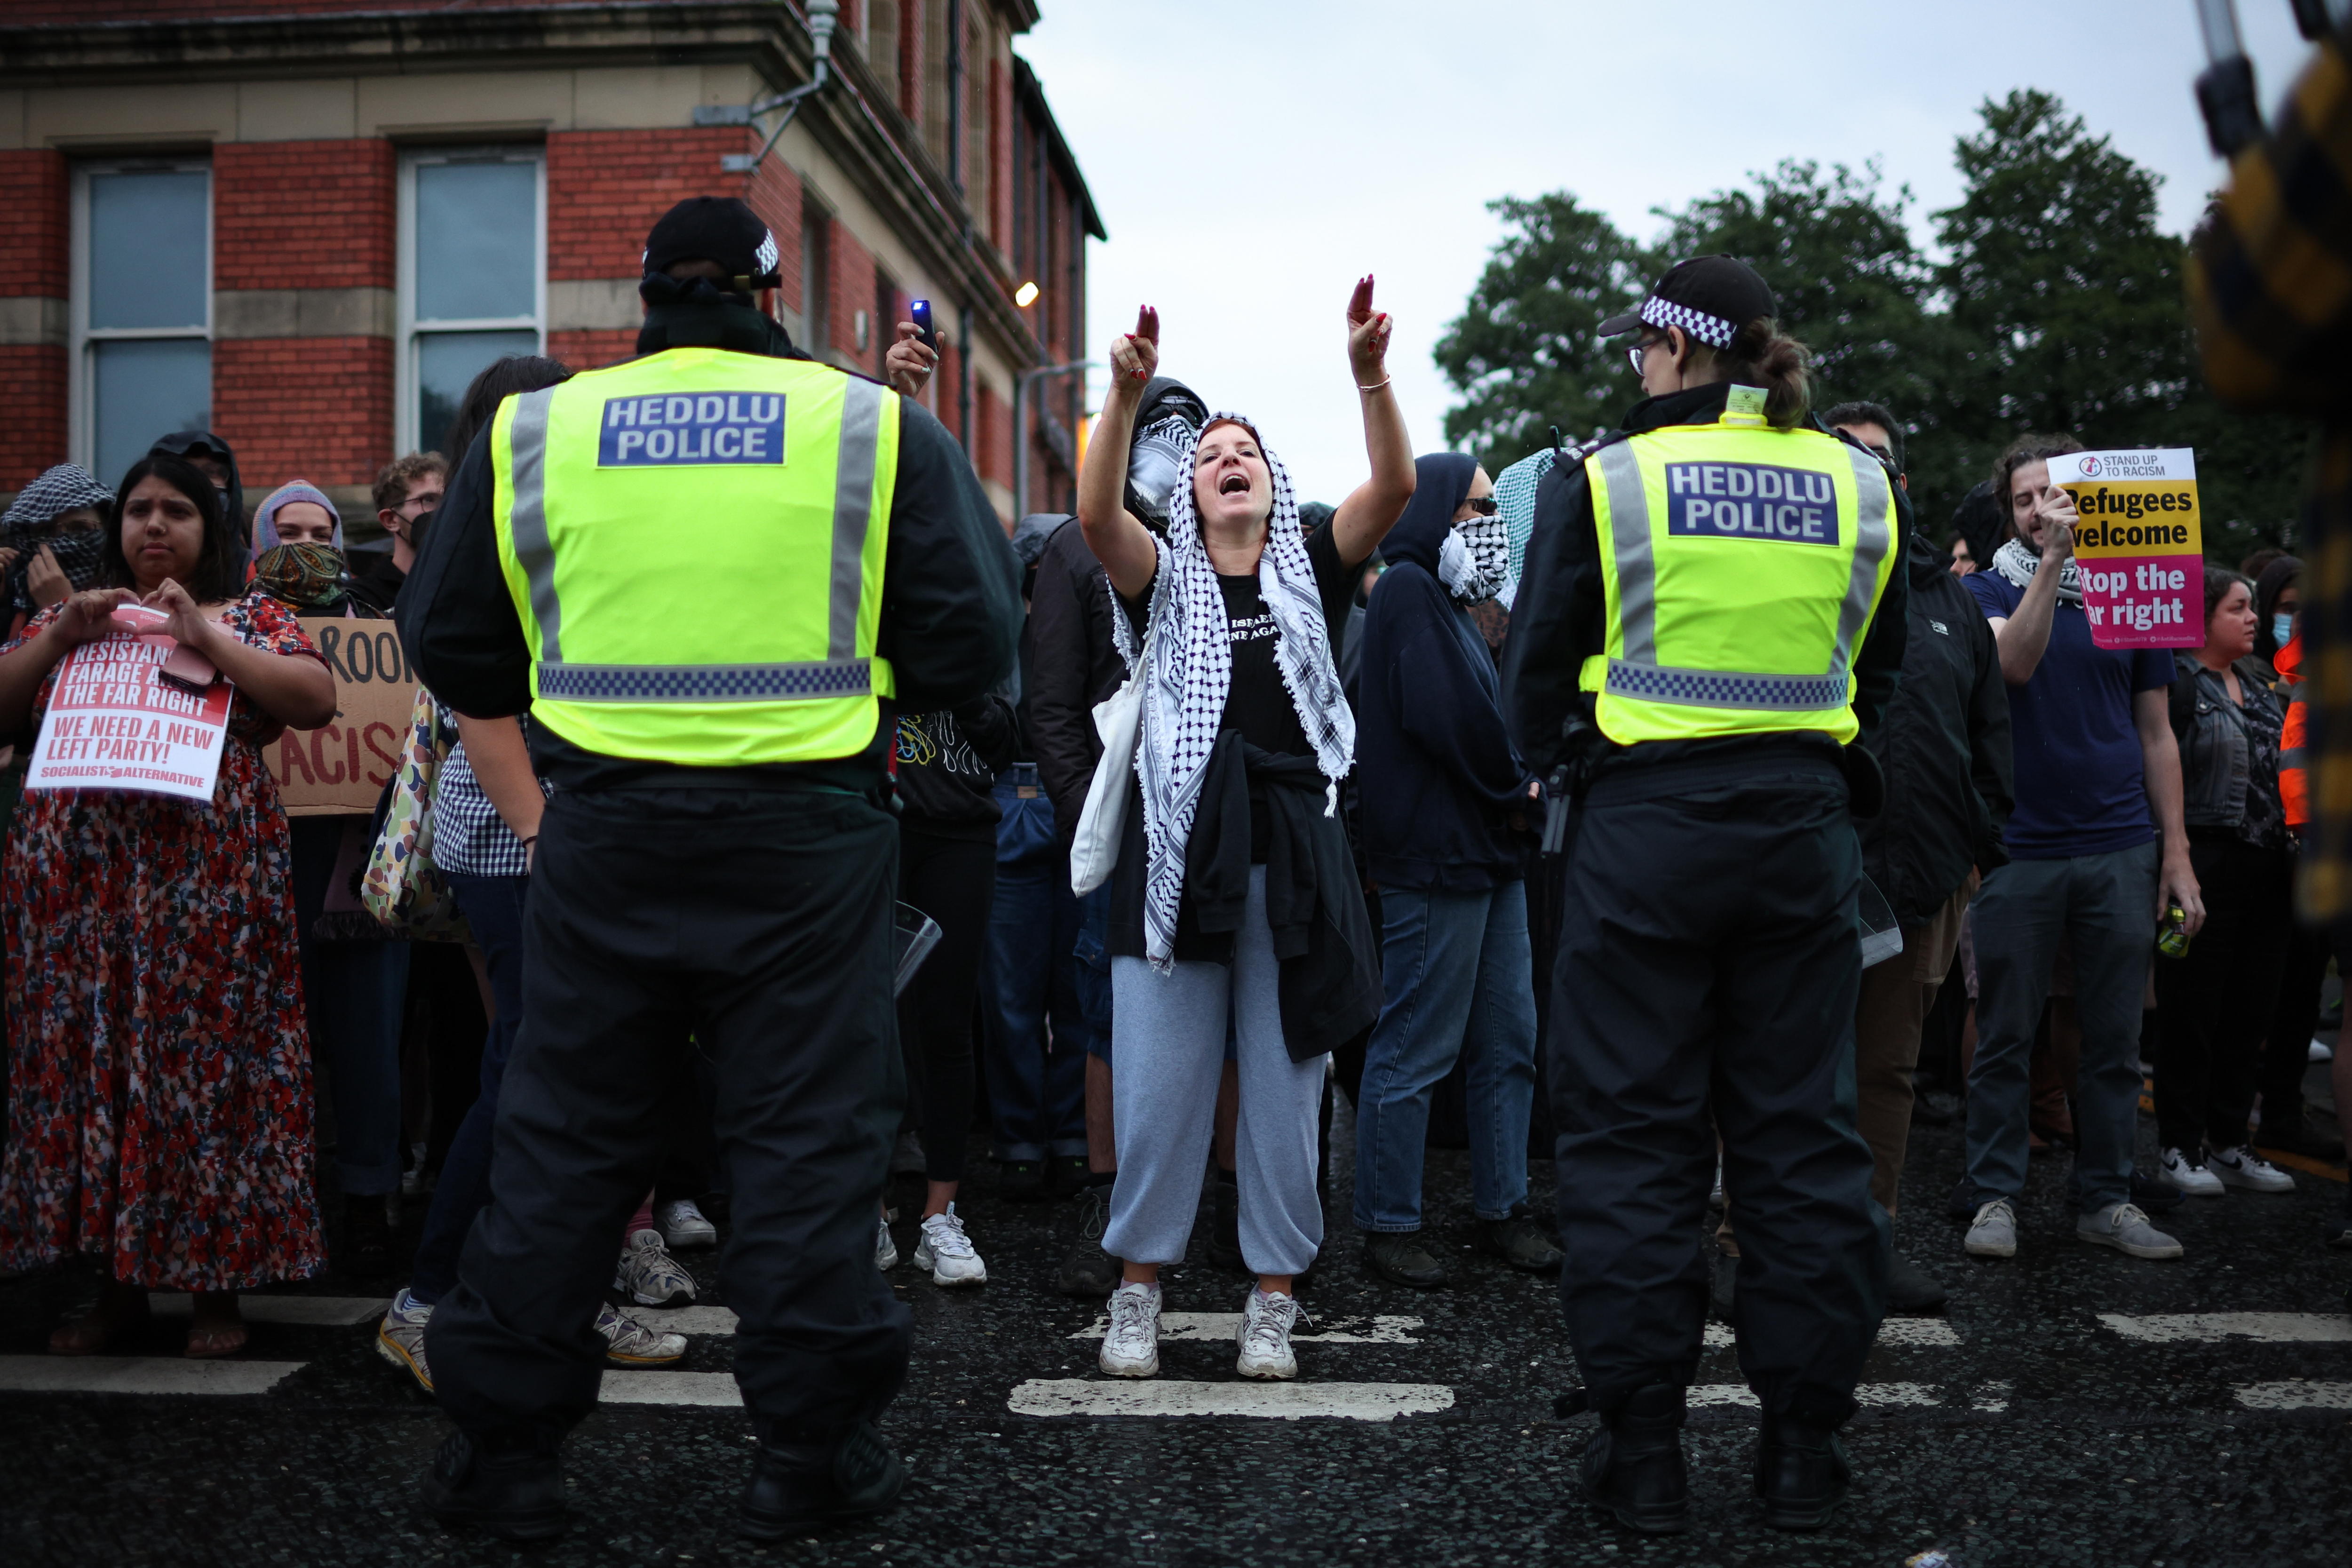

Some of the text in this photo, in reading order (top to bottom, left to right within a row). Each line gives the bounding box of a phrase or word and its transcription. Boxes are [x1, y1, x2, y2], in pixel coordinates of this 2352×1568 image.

[608, 395, 780, 427] HEDDLU
[617, 427, 767, 460] POLICE
[2103, 455, 2158, 466] STAND UP
[2105, 466, 2165, 477] TO RACISM
[1671, 465, 1831, 504] HEDDLU
[1685, 499, 1825, 538] POLICE
[2135, 564, 2185, 591] the
[2085, 597, 2184, 631] ar right
[73, 641, 174, 665] RESISTAN
[67, 662, 143, 684] FARAGE
[62, 684, 208, 717] THE FAR RIGHT
[53, 716, 215, 750] WE NEED A NEW
[46, 738, 171, 764] LEFT PARTY!
[272, 721, 413, 788] ACIS
[40, 765, 205, 788] SOCIALIST ALTERNATIVE
